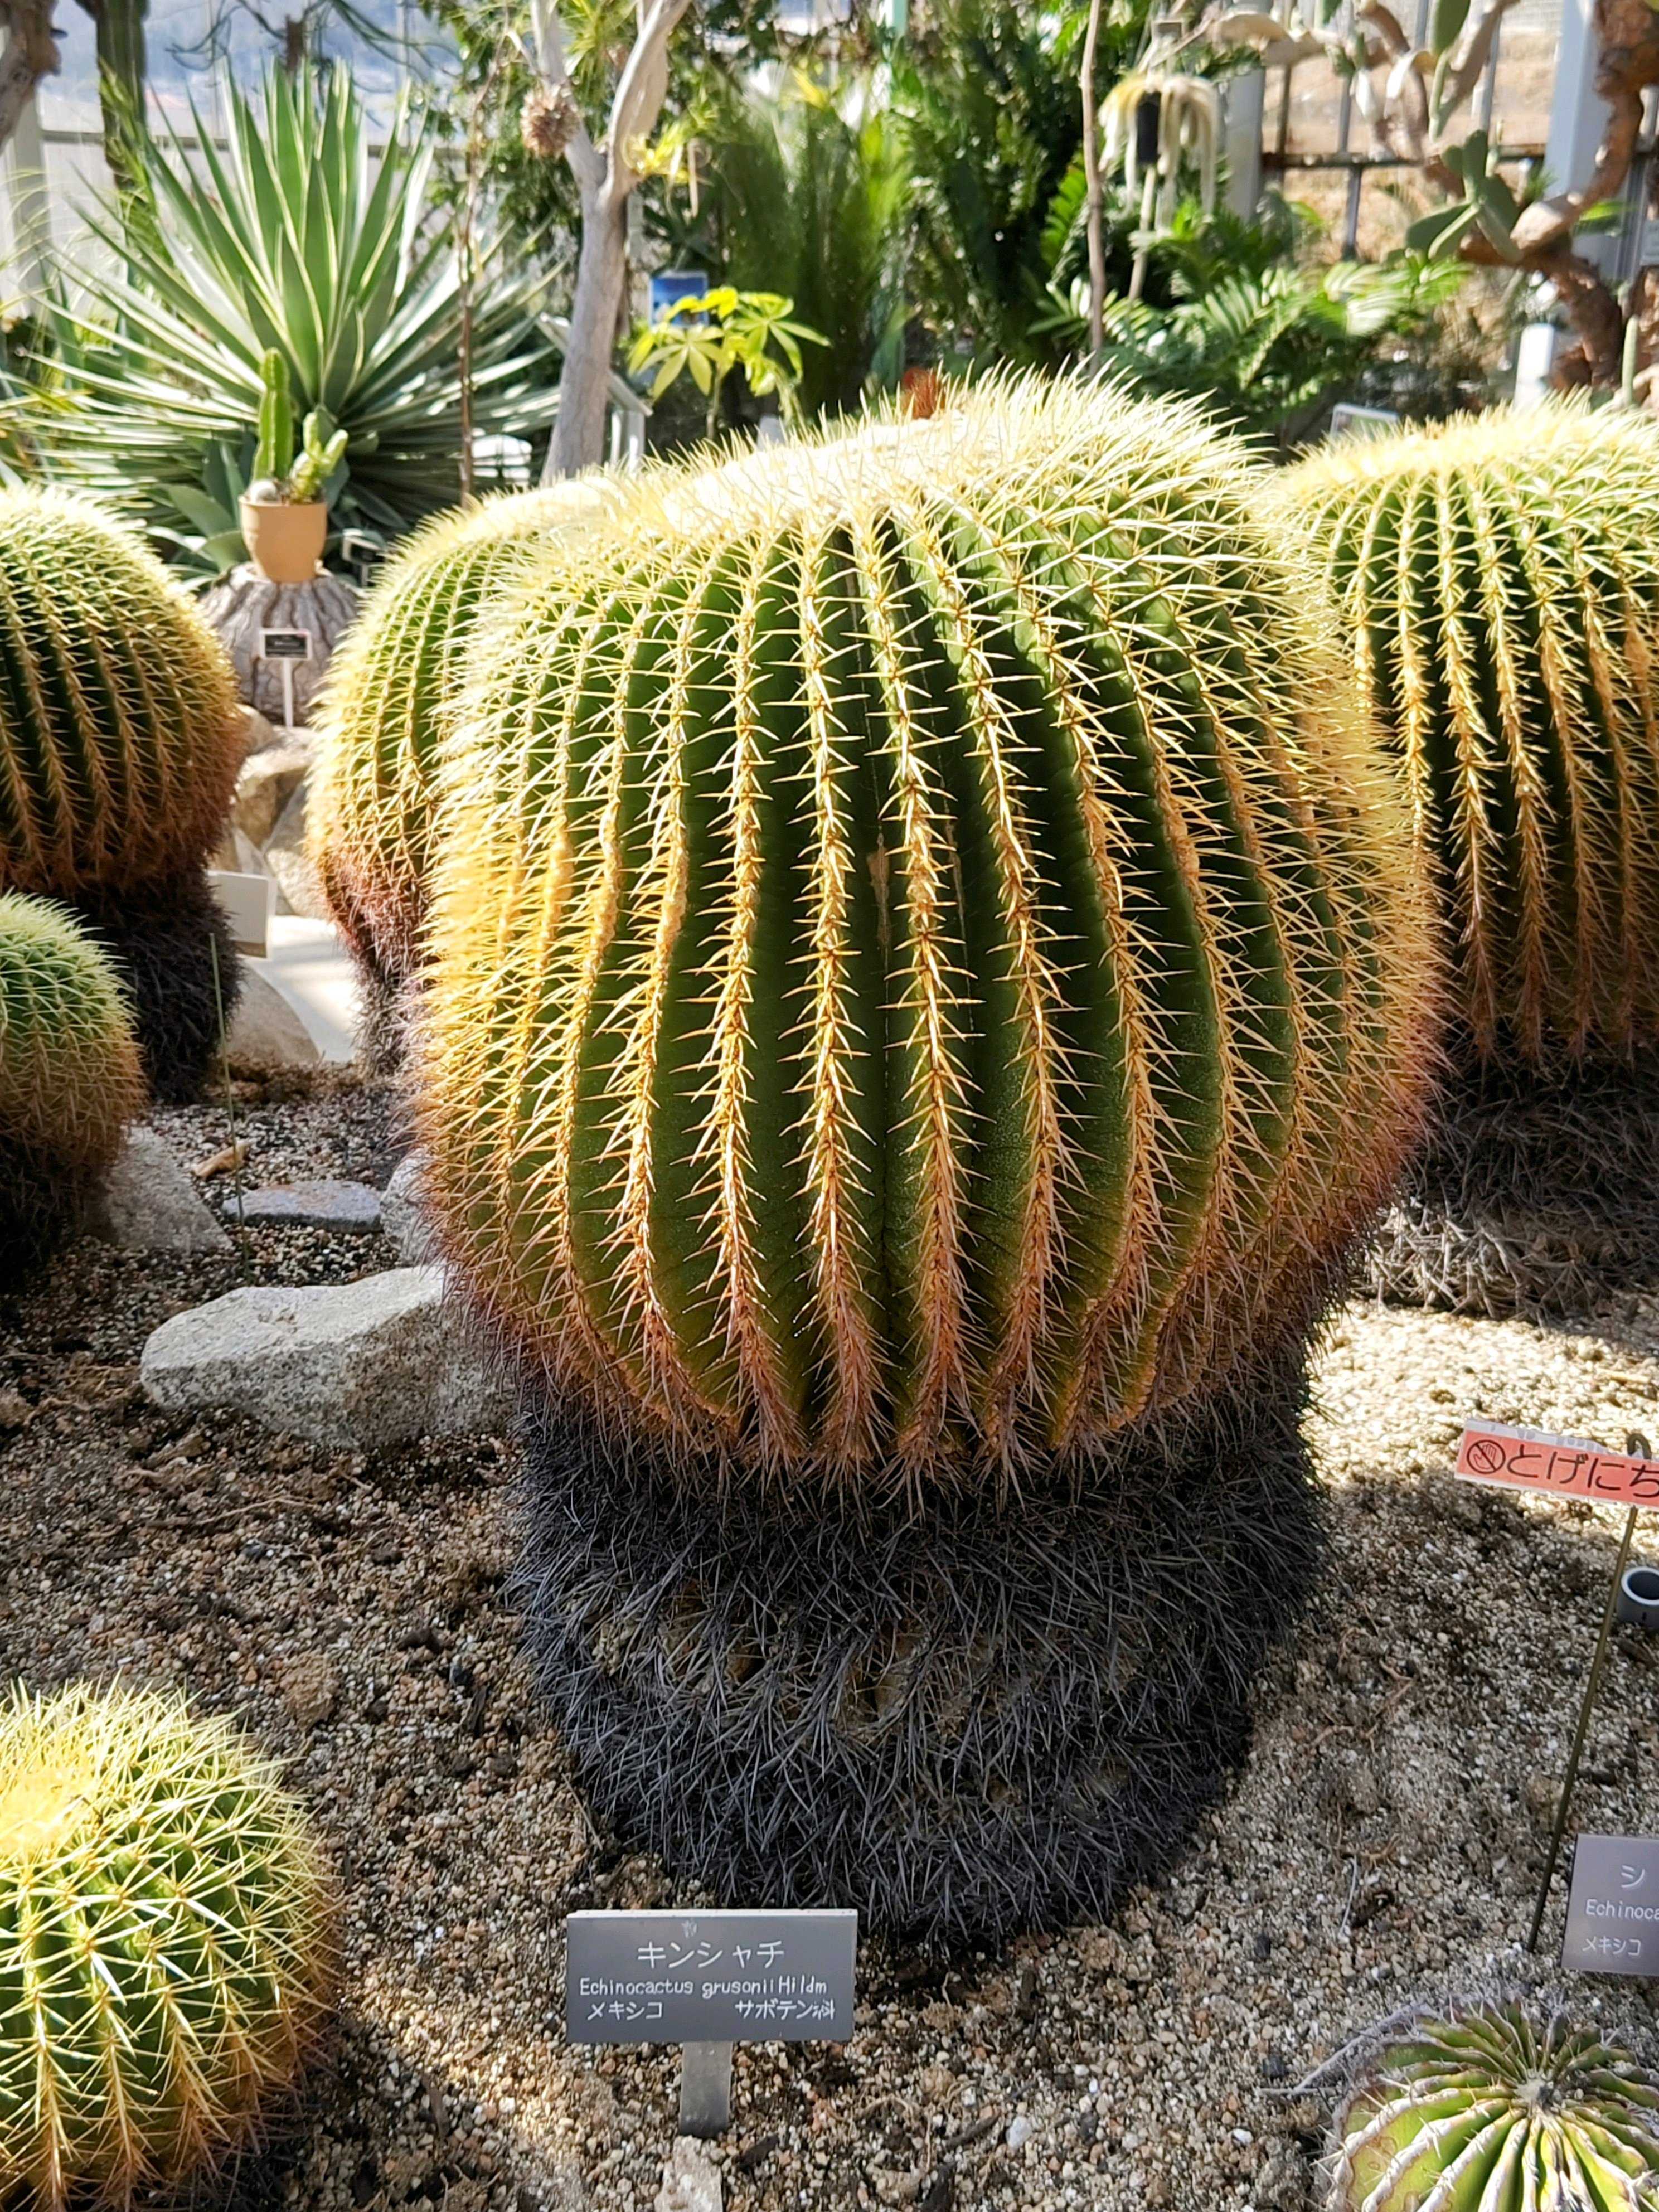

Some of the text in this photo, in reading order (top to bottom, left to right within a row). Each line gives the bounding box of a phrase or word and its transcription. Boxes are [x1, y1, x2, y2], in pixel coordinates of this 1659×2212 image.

[1507, 1444, 1659, 1498] とげにち
[638, 1941, 784, 1969] キンシャチ
[1583, 1935, 1641, 1956] メキシコ
[580, 1977, 693, 1996] Echinocactus
[779, 1974, 827, 1996] Hildm
[587, 1997, 836, 2021] メキシコ サボテン科
